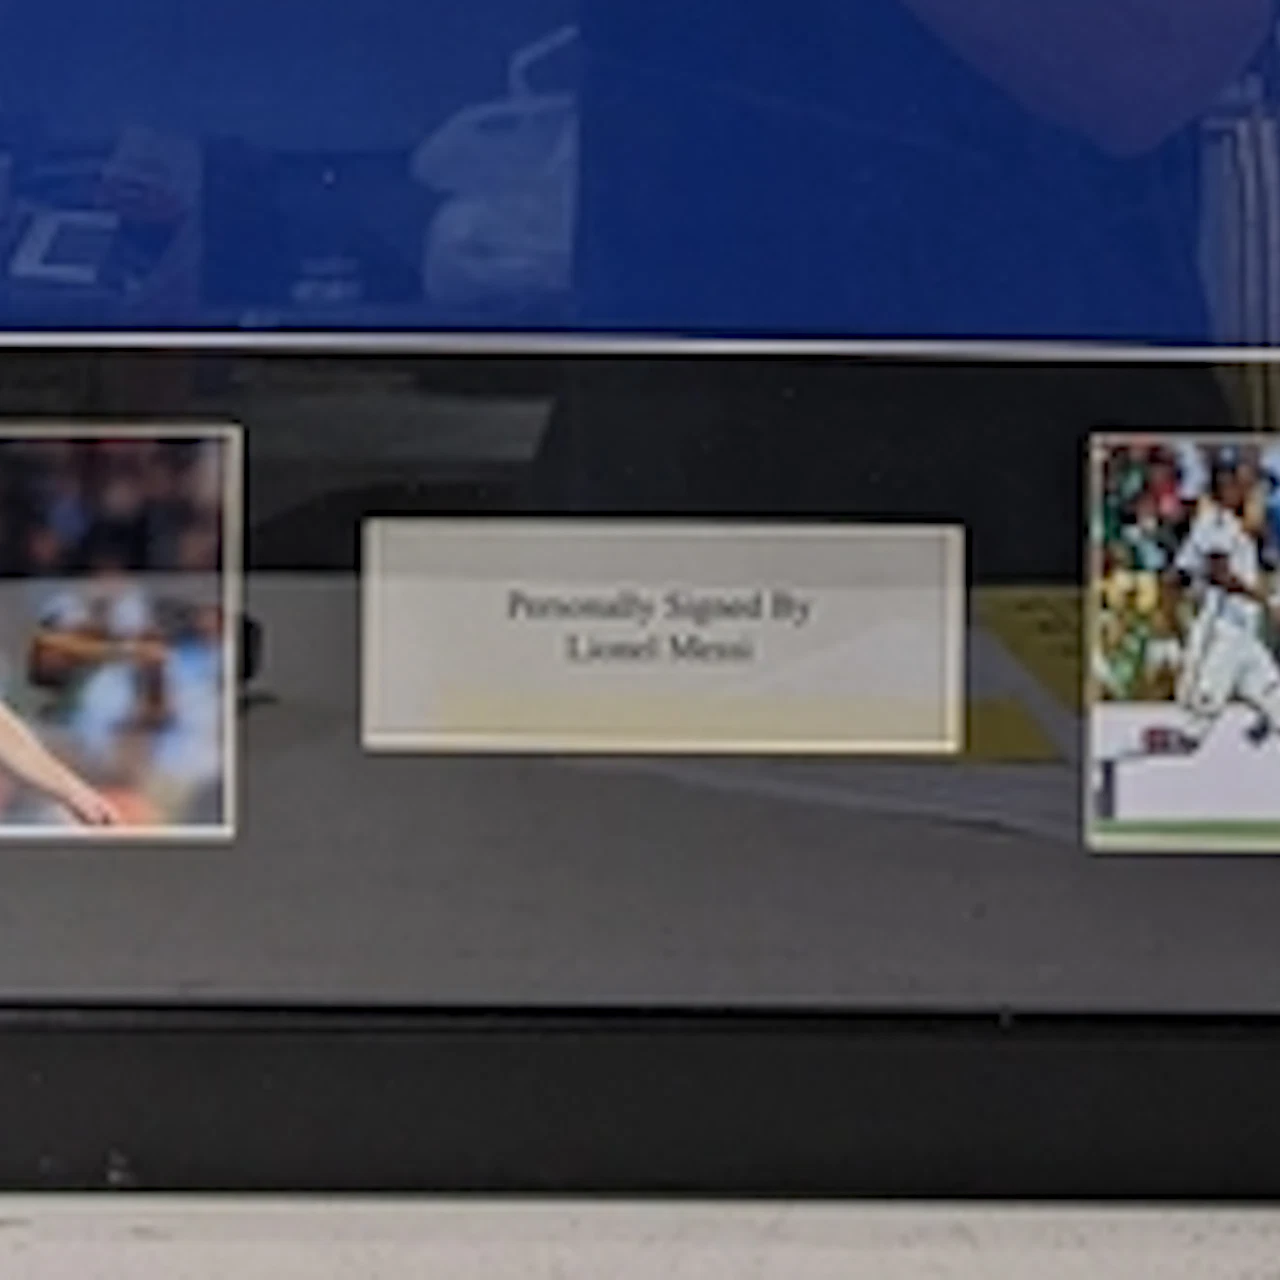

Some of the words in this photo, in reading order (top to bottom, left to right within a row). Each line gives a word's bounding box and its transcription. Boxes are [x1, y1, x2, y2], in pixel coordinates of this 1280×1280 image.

[508, 588, 655, 629] Personally
[663, 587, 763, 628] Signed
[772, 589, 813, 630] By
[566, 634, 659, 662] Lionel
[670, 634, 756, 662] Messi
